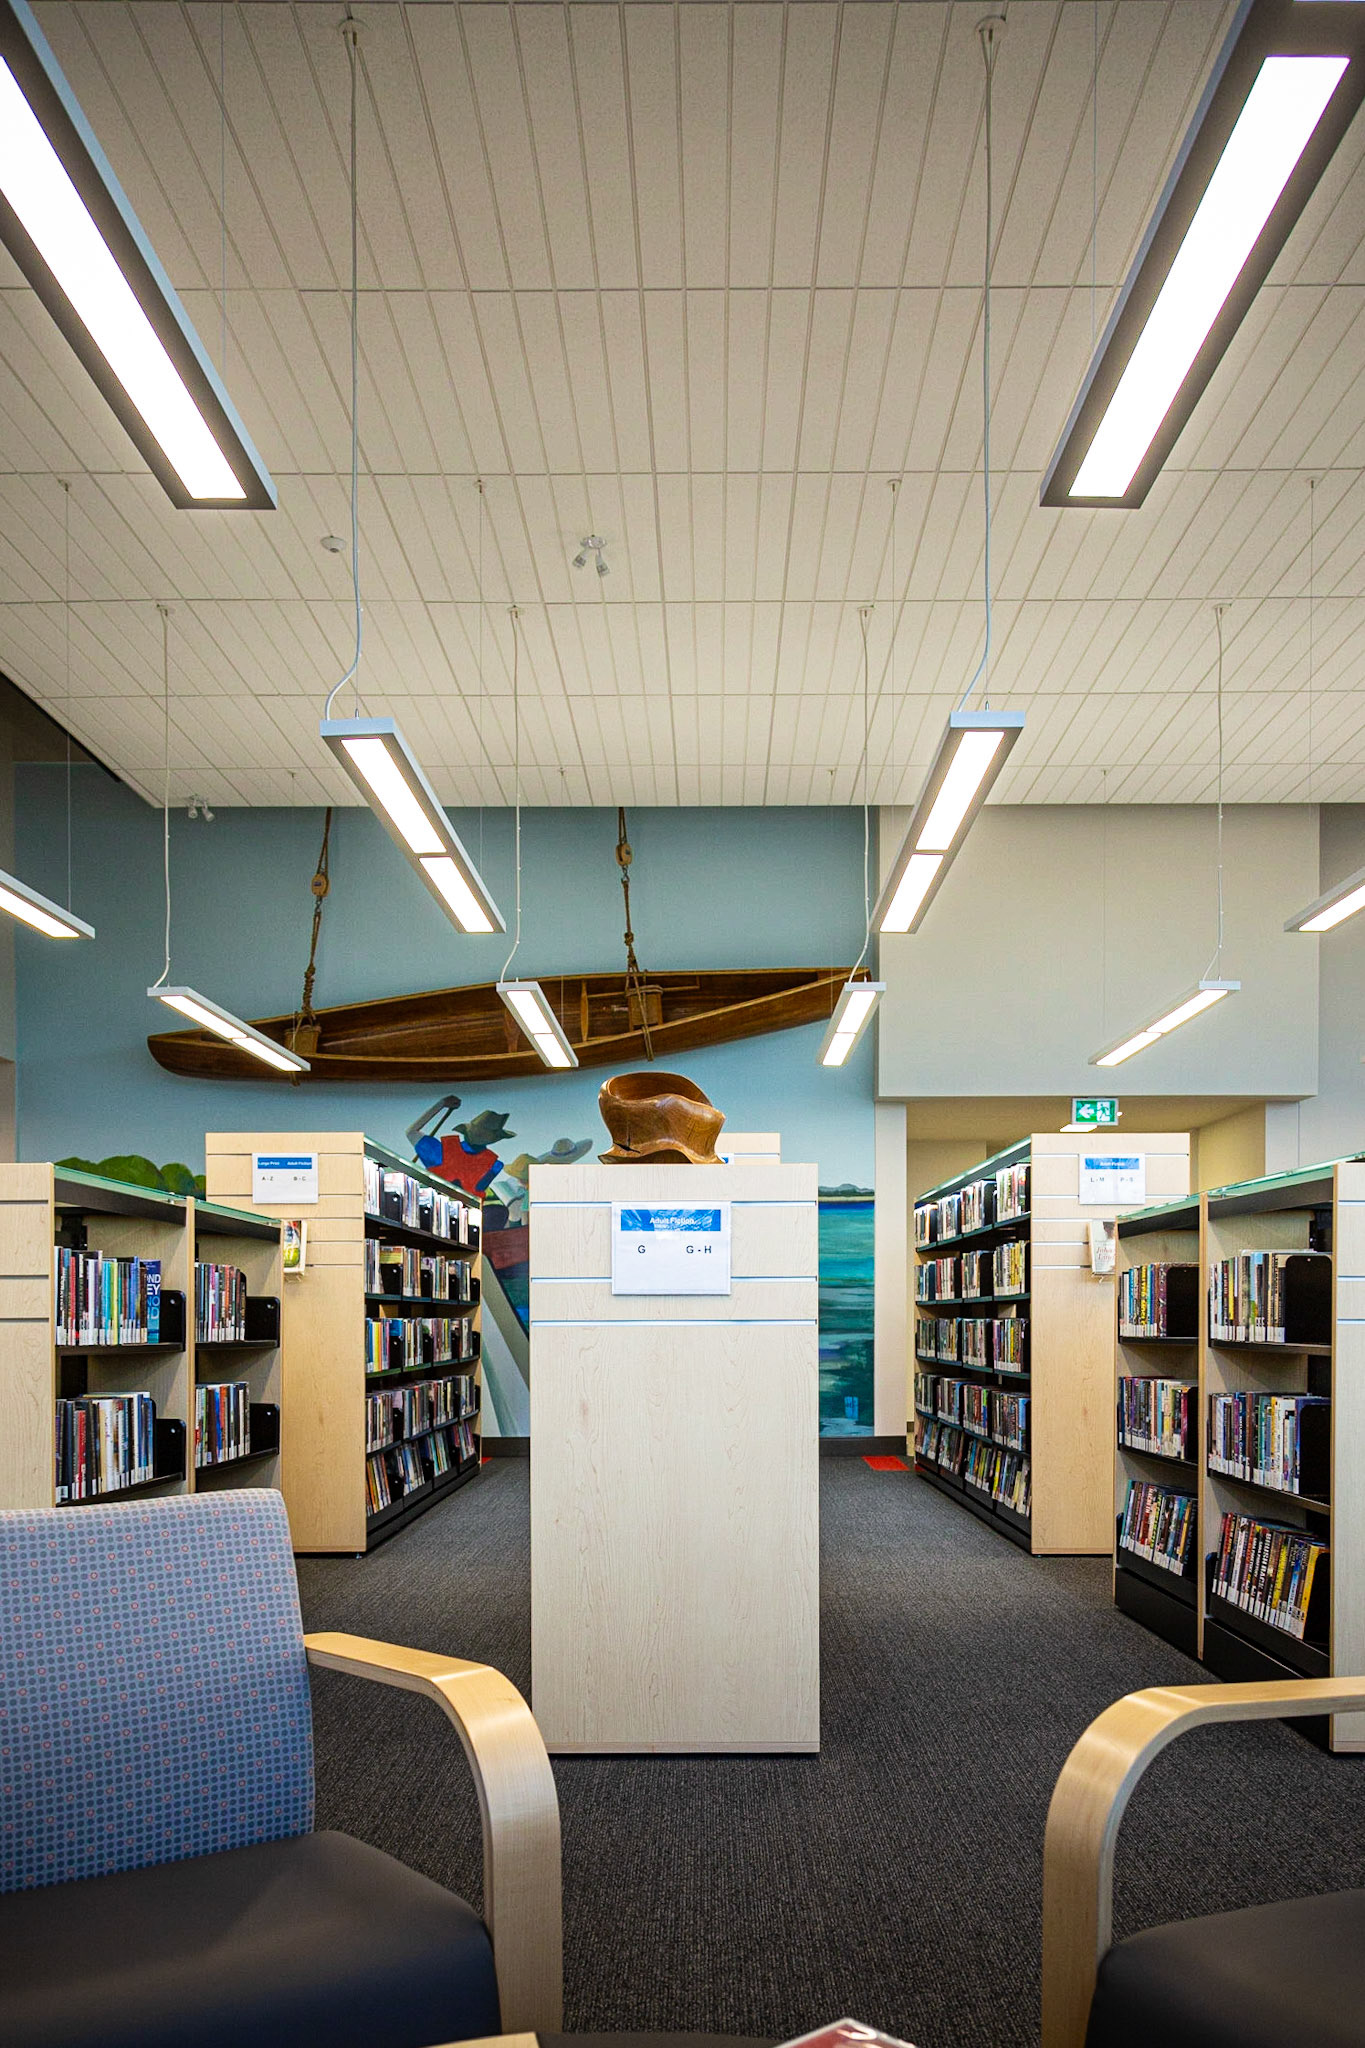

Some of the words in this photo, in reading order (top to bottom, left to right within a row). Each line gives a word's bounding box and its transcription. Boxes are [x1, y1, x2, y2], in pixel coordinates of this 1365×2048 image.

[670, 1217, 695, 1225] Fiction
[637, 1245, 646, 1254] G
[686, 1245, 694, 1254] G
[704, 1245, 712, 1254] H
